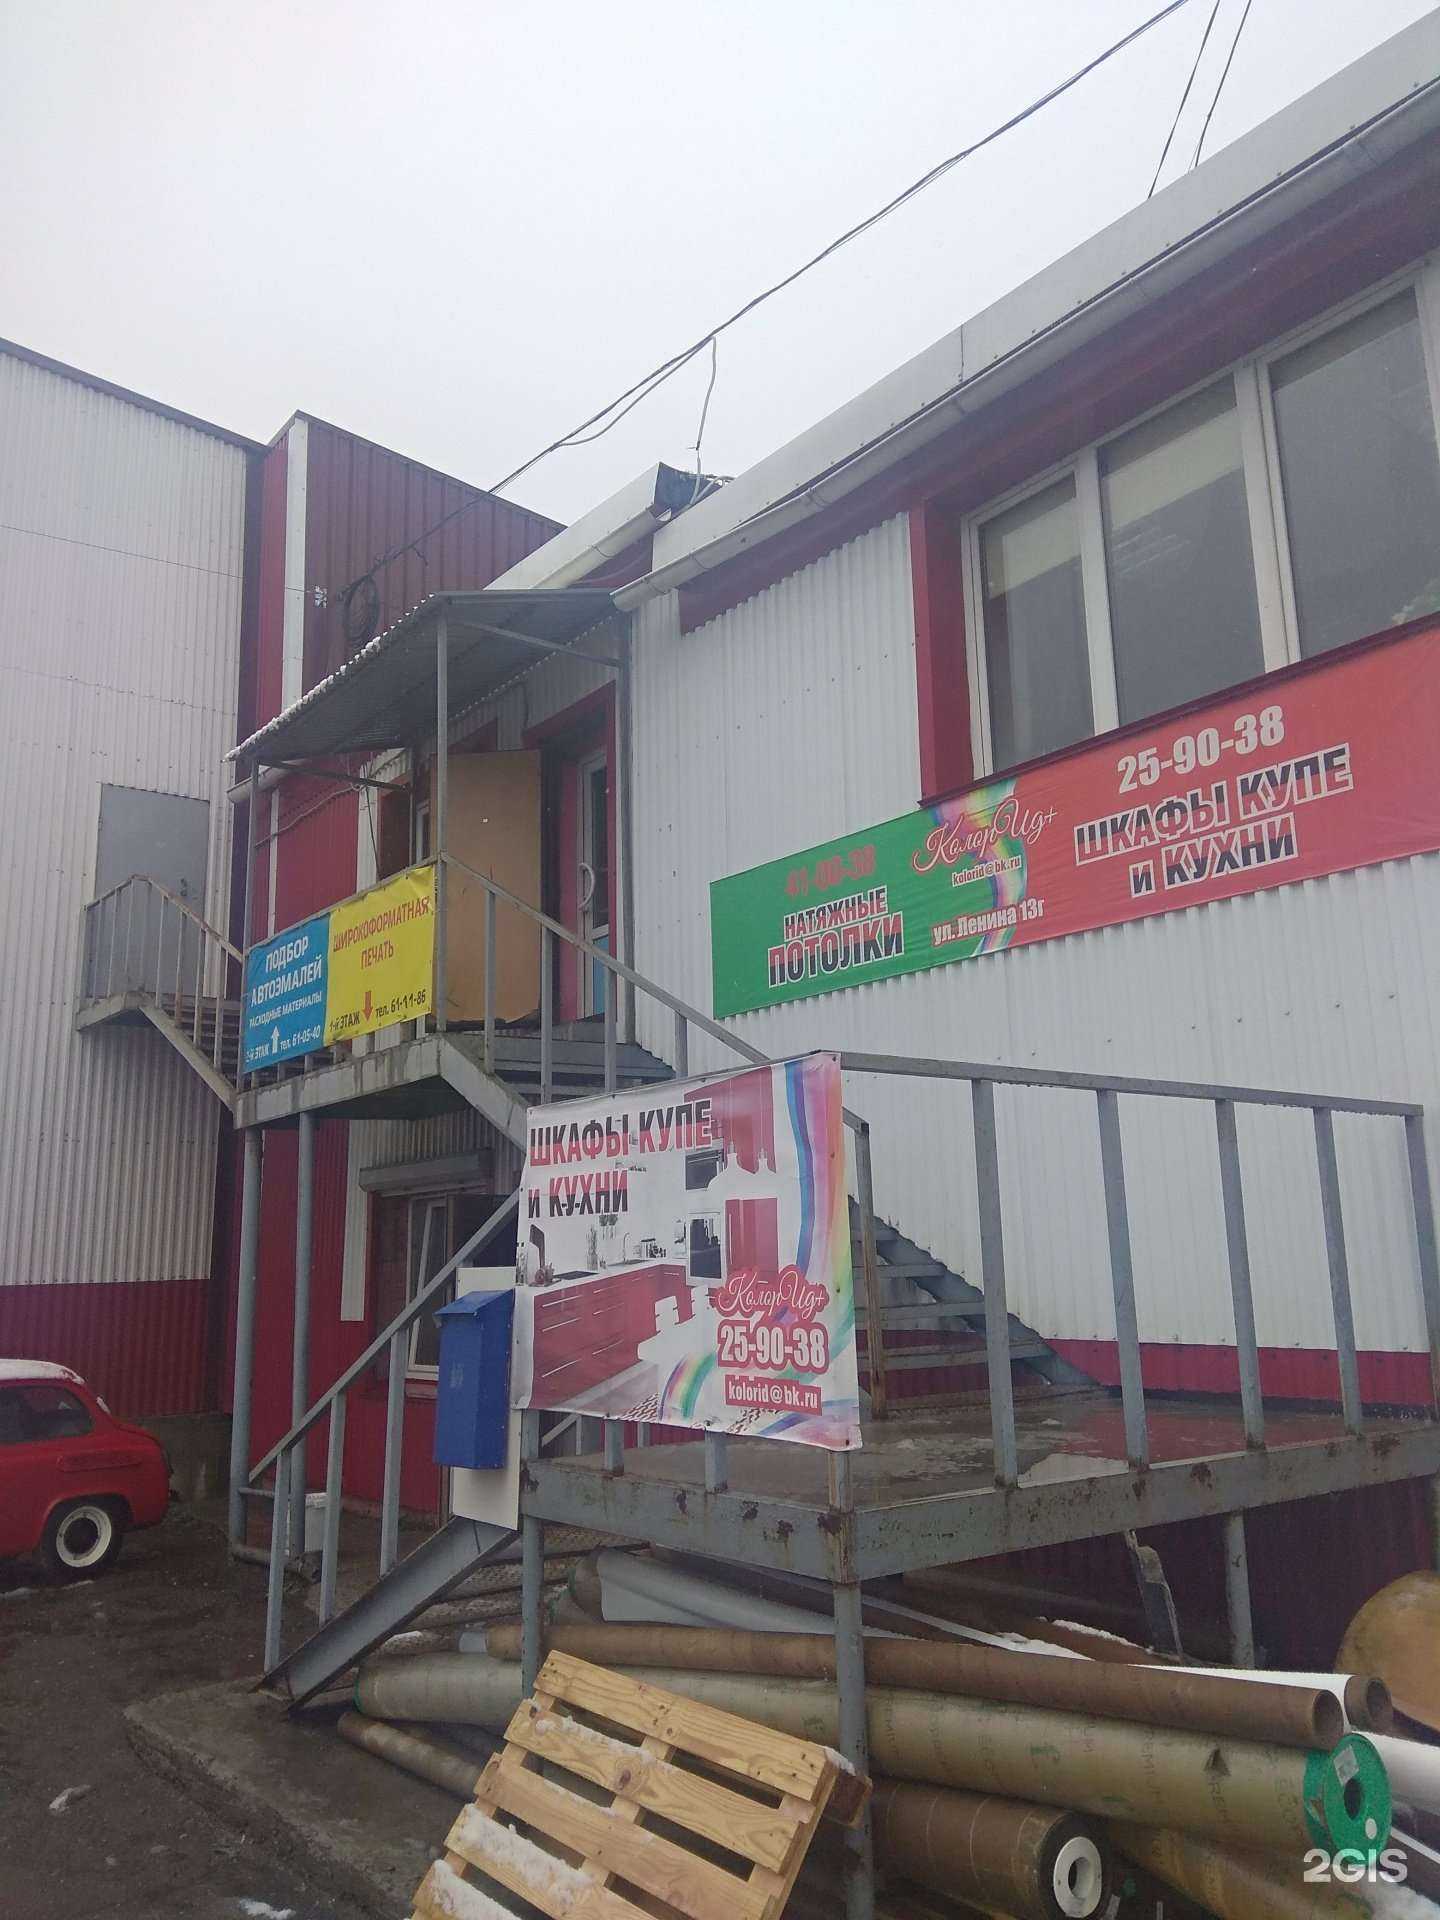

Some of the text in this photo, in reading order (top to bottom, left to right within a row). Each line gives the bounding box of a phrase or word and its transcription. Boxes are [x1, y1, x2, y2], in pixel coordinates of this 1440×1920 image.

[1117, 705, 1285, 794] 25-90-38
[1073, 742, 1354, 866] ШКАФЫ КУПЕ
[951, 855, 1022, 887] kolorid@bk.ru
[1161, 812, 1299, 890] КУХНИ
[333, 896, 430, 952] ШИРОКОФОРМАТНАЯ
[784, 885, 888, 941] НАТЯЖНЫЕ
[956, 907, 1017, 937] Ленина
[1019, 898, 1045, 922] 13г
[265, 936, 309, 973] ПОДБОР
[360, 940, 394, 969] ПЕЧАТЬ
[768, 911, 904, 988] ПОТОЛКИ
[251, 954, 322, 1007] АВТОЭМАЛЕЙ
[249, 991, 322, 1028] РАСХОДНЫЕ МАТЕРИАЛЫ
[340, 1011, 360, 1029] ЭТАЖ
[529, 1099, 713, 1167] ШКАФЫ КУПЕ
[548, 1169, 629, 1217] КУХНИ
[720, 1325, 826, 1369] 25-90-38
[728, 1380, 818, 1408] kolorid@bk.ru
